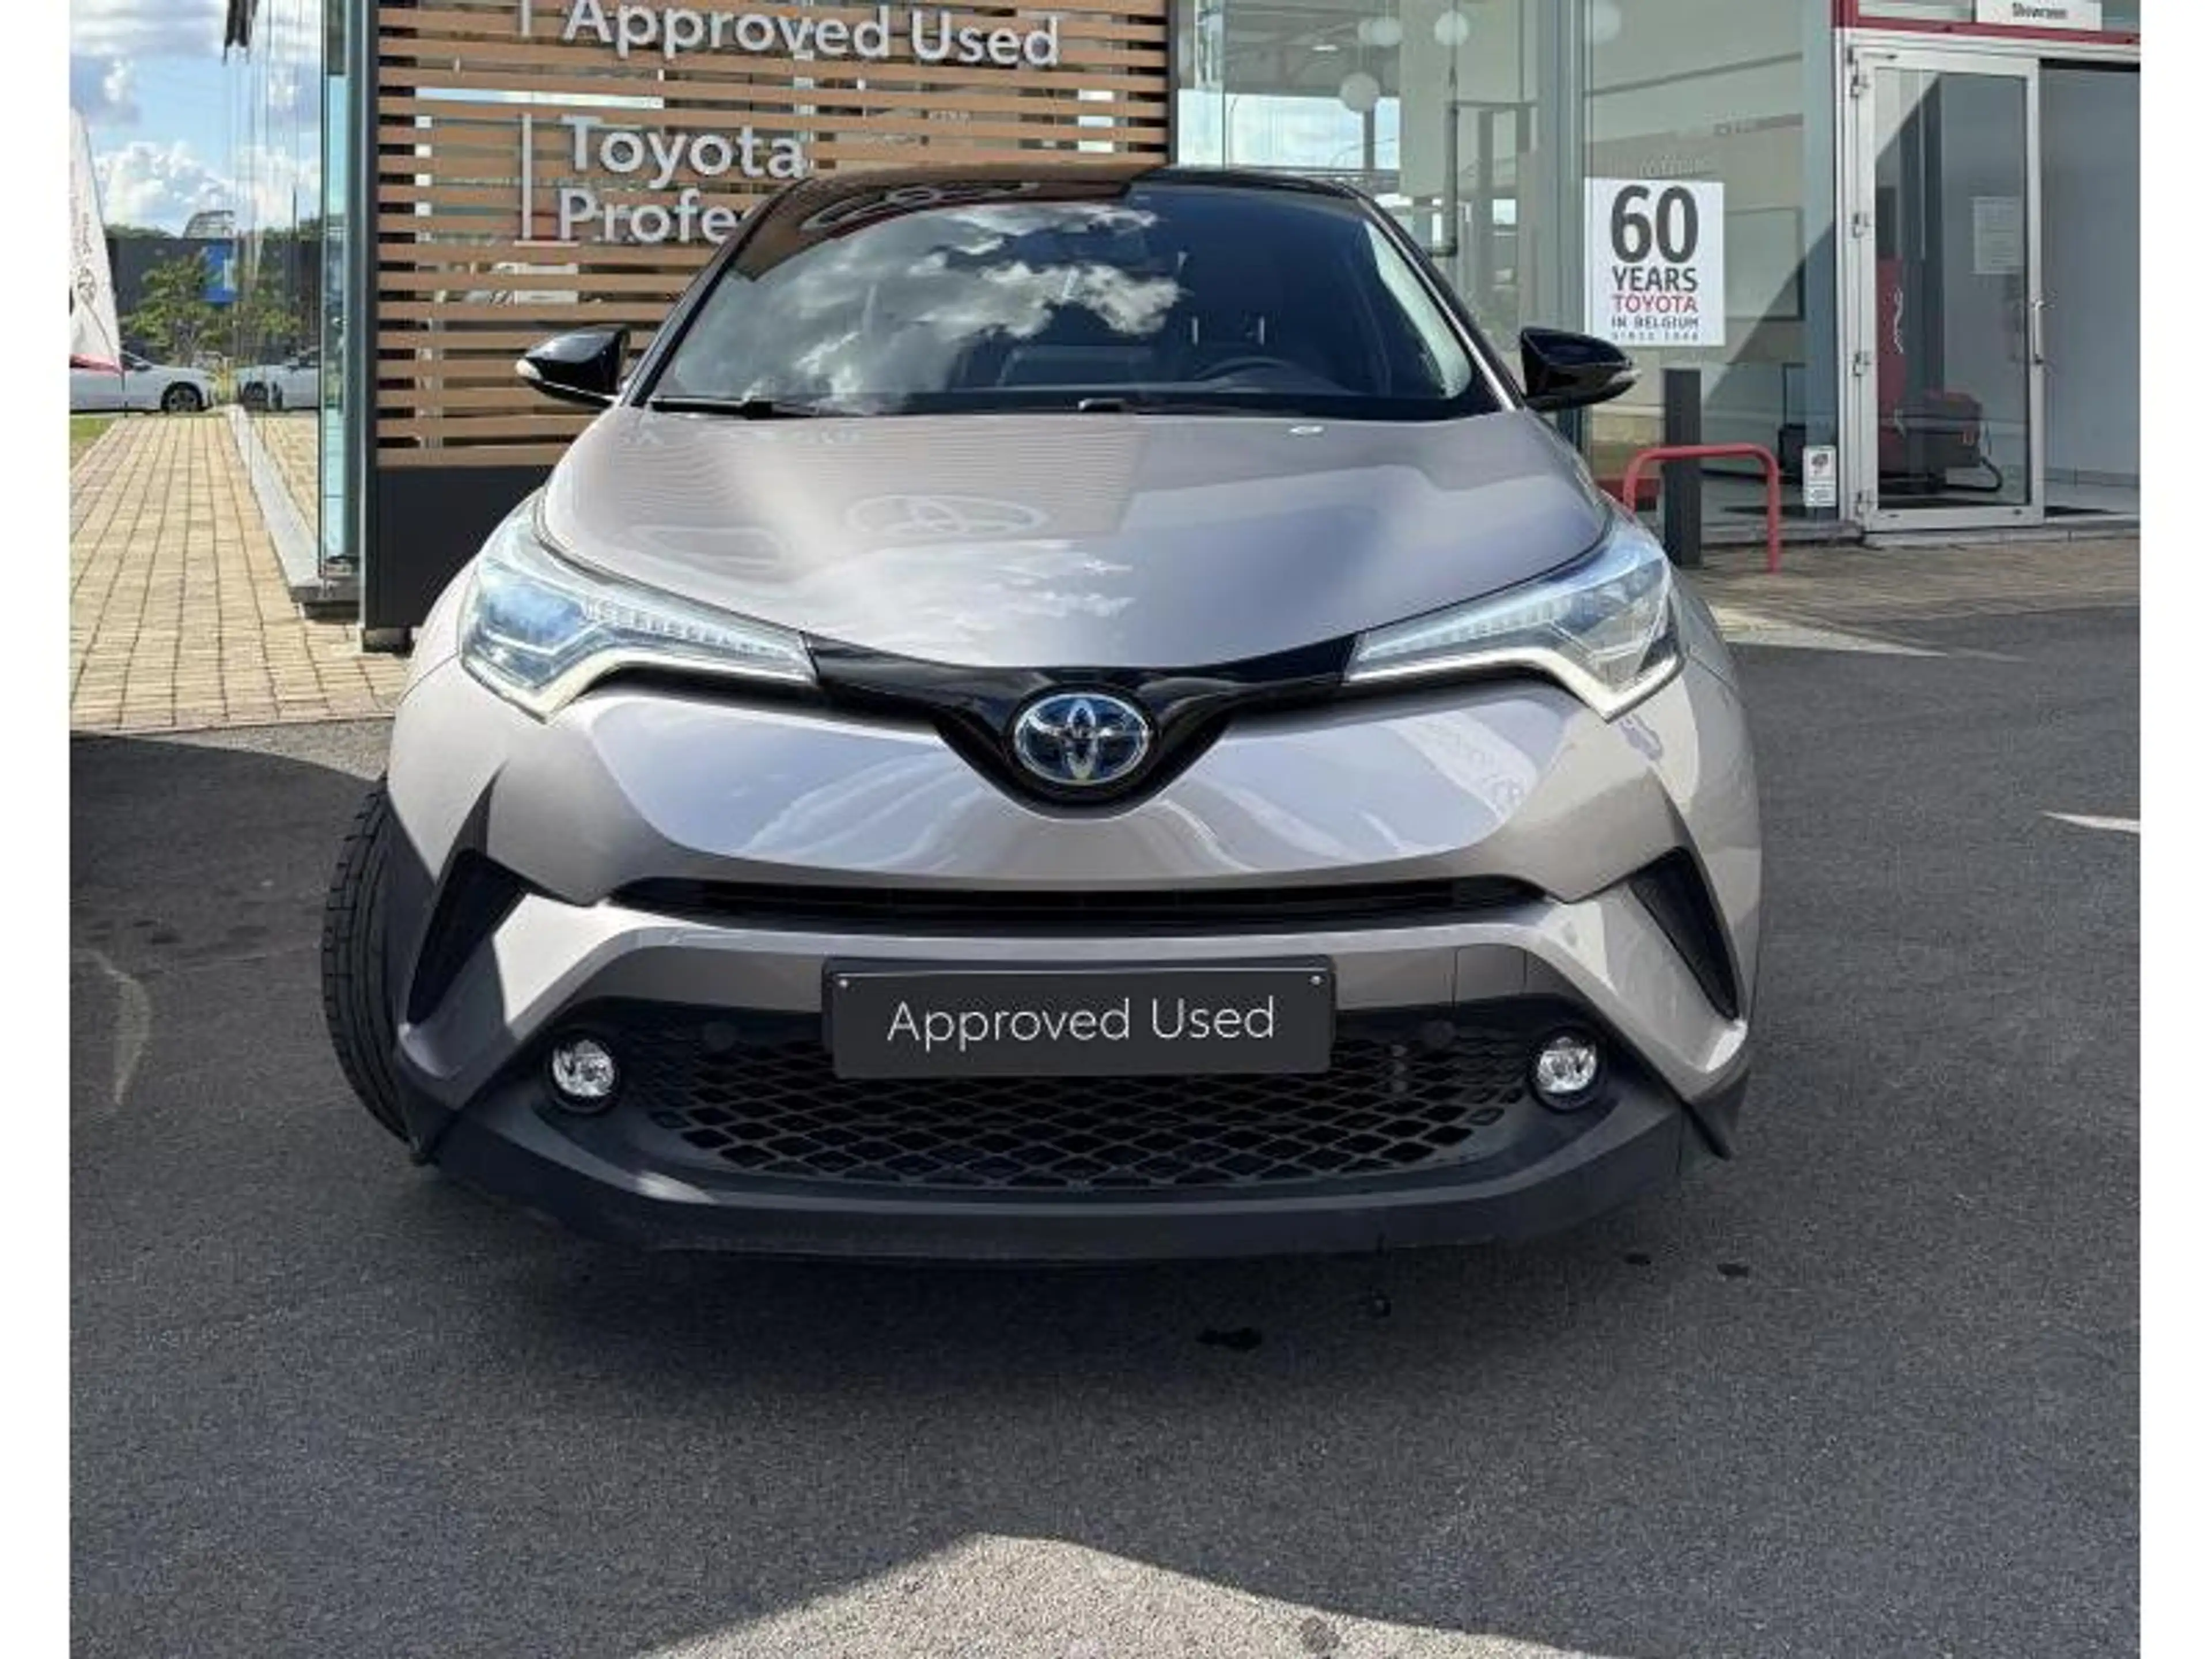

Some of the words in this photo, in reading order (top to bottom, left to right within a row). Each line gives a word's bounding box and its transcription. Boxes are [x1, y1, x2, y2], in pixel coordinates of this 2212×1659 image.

[563, 0, 889, 59] Approved
[912, 5, 1059, 66] Used
[560, 116, 805, 189] Toyota
[560, 188, 753, 244] Profe
[1611, 185, 1698, 263] 60
[1612, 266, 1698, 292] YEARS
[1612, 294, 1699, 313] TOYOTA
[1612, 316, 1626, 327] IN
[1635, 316, 1699, 329] BELGIUM
[888, 997, 1129, 1052] Approved
[1153, 995, 1274, 1039] Used
